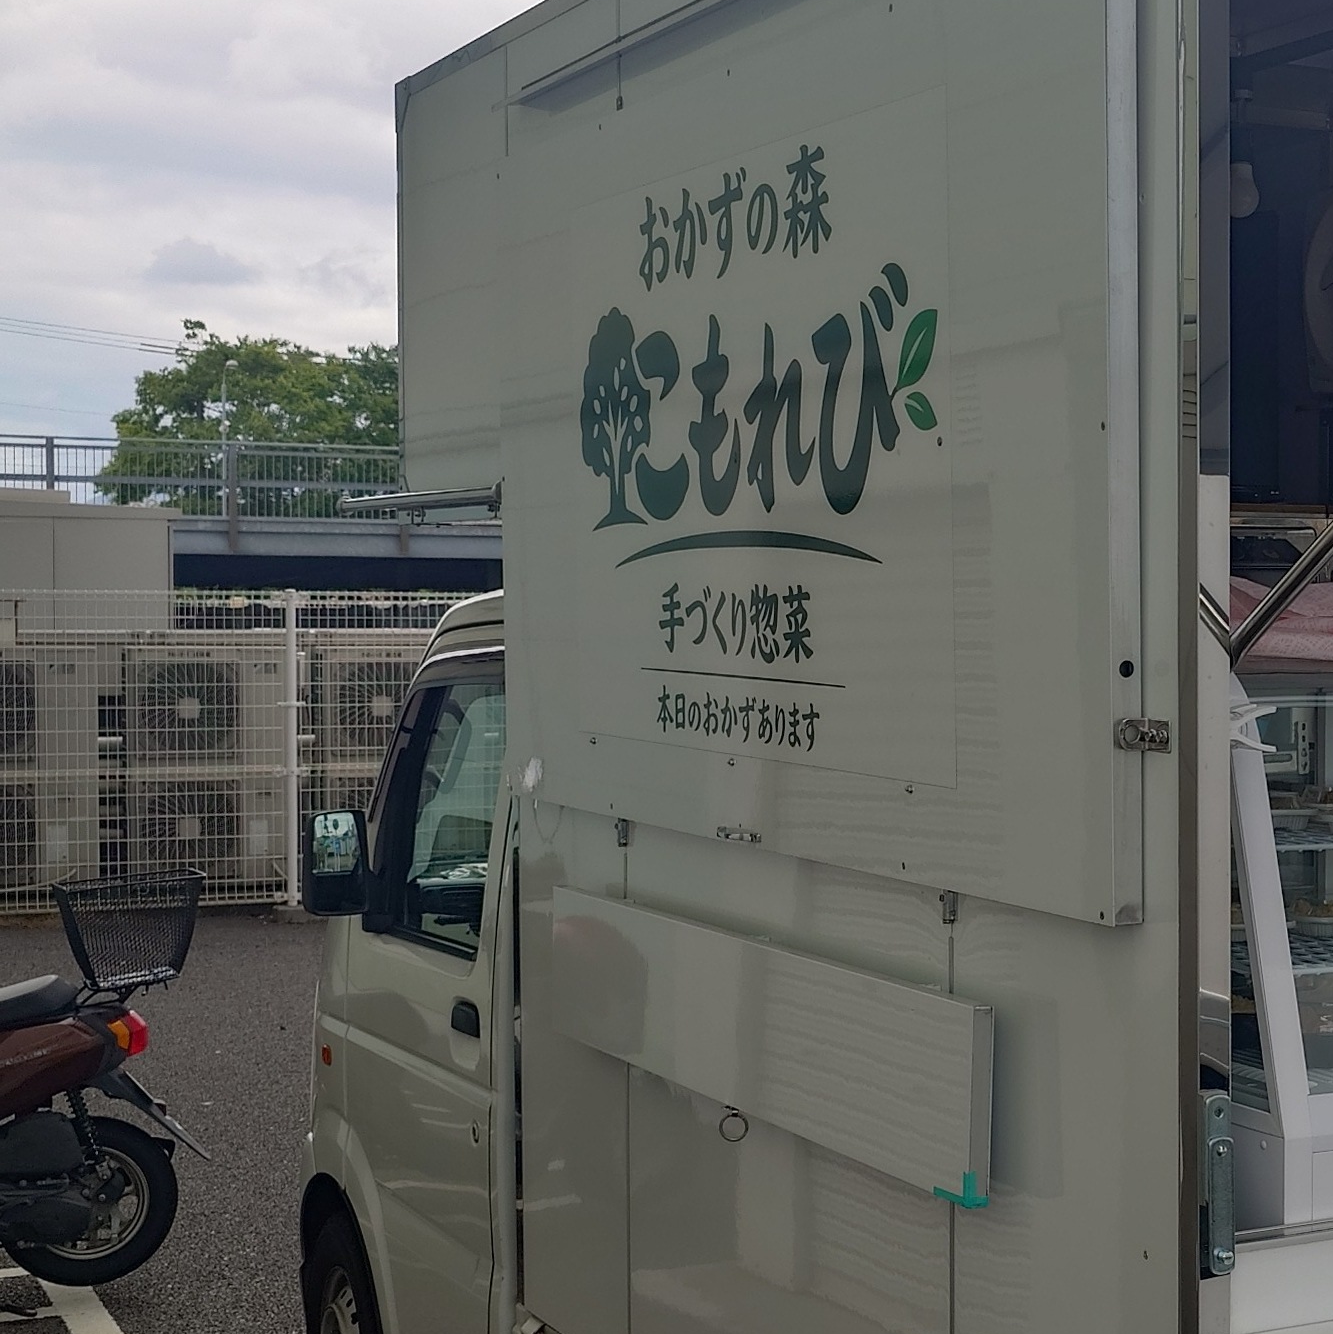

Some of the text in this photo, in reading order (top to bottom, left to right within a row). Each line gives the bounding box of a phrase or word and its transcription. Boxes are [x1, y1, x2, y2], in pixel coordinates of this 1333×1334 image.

[638, 144, 833, 292] おかずの森
[634, 262, 909, 521] こもれび
[658, 581, 815, 665] 手づくり惣菜
[656, 685, 821, 752] 本日のおかずあります
